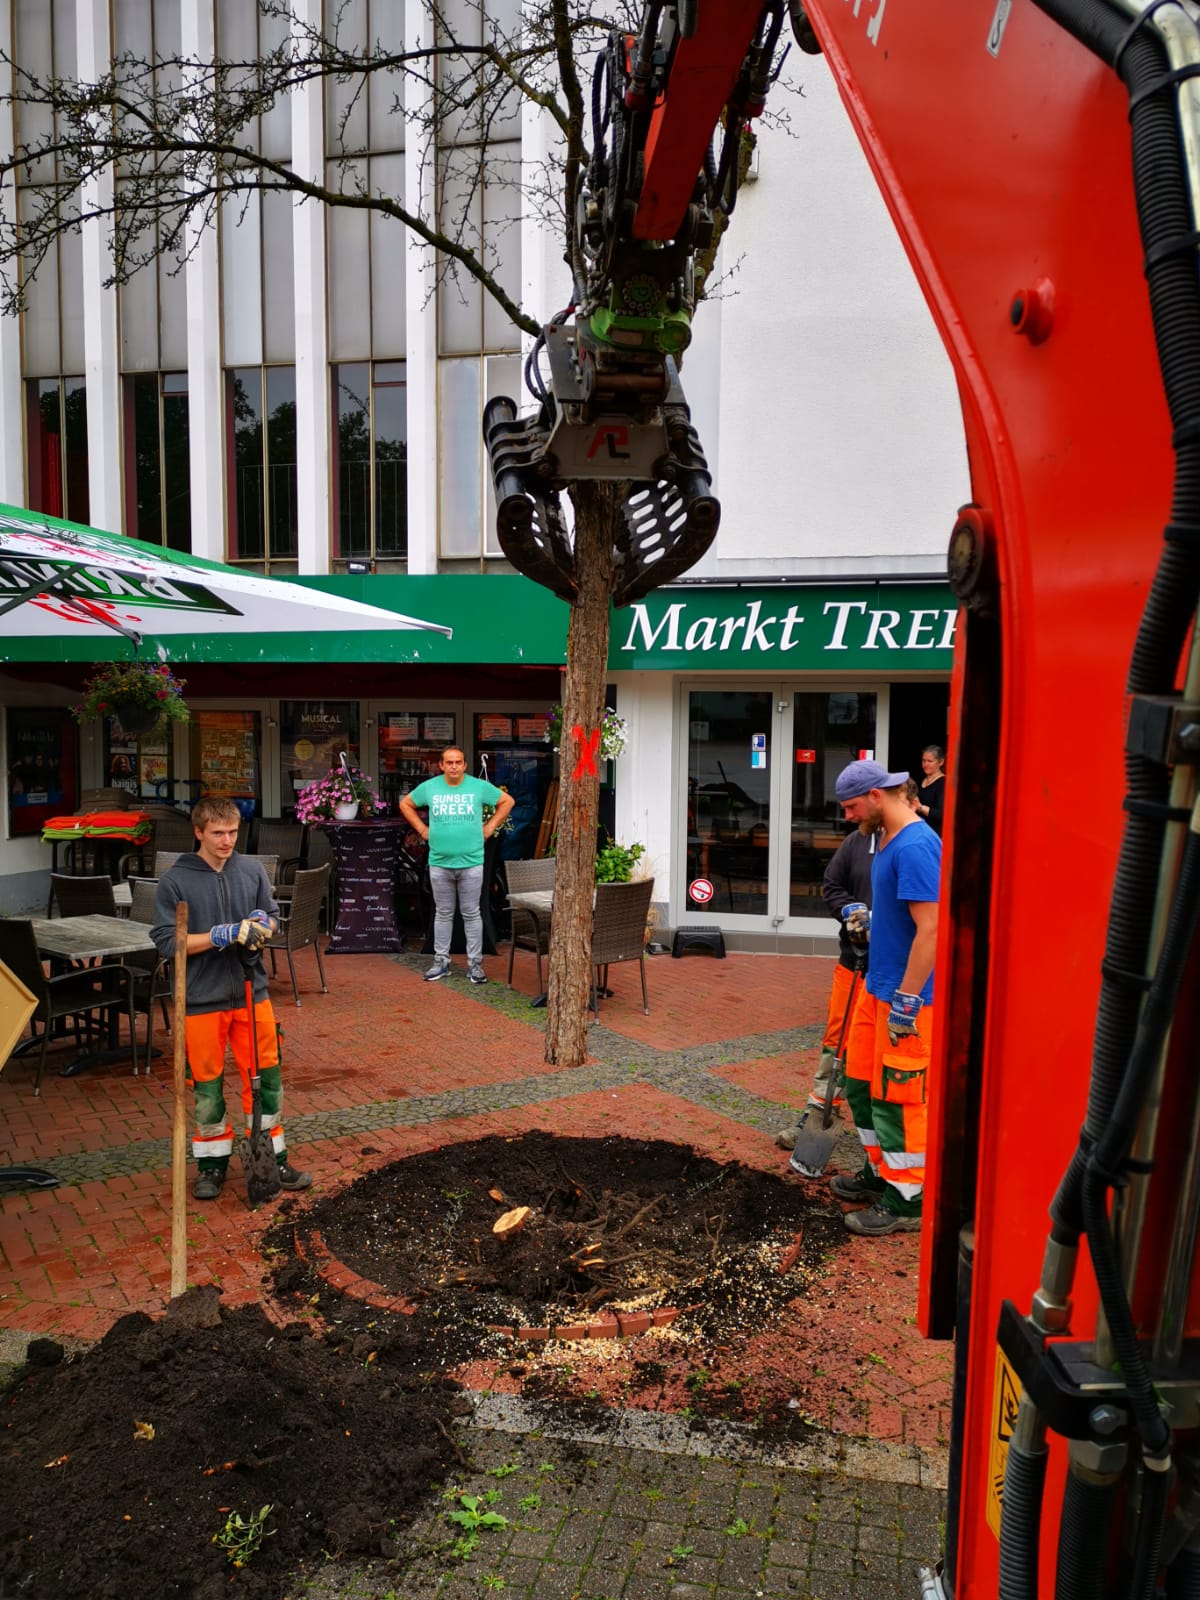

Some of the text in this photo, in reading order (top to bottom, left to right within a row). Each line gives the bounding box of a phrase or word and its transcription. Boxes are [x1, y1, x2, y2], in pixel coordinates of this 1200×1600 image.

[621, 600, 804, 651] Markt
[432, 793, 475, 804] SUNSET
[432, 803, 475, 816] CREEK
